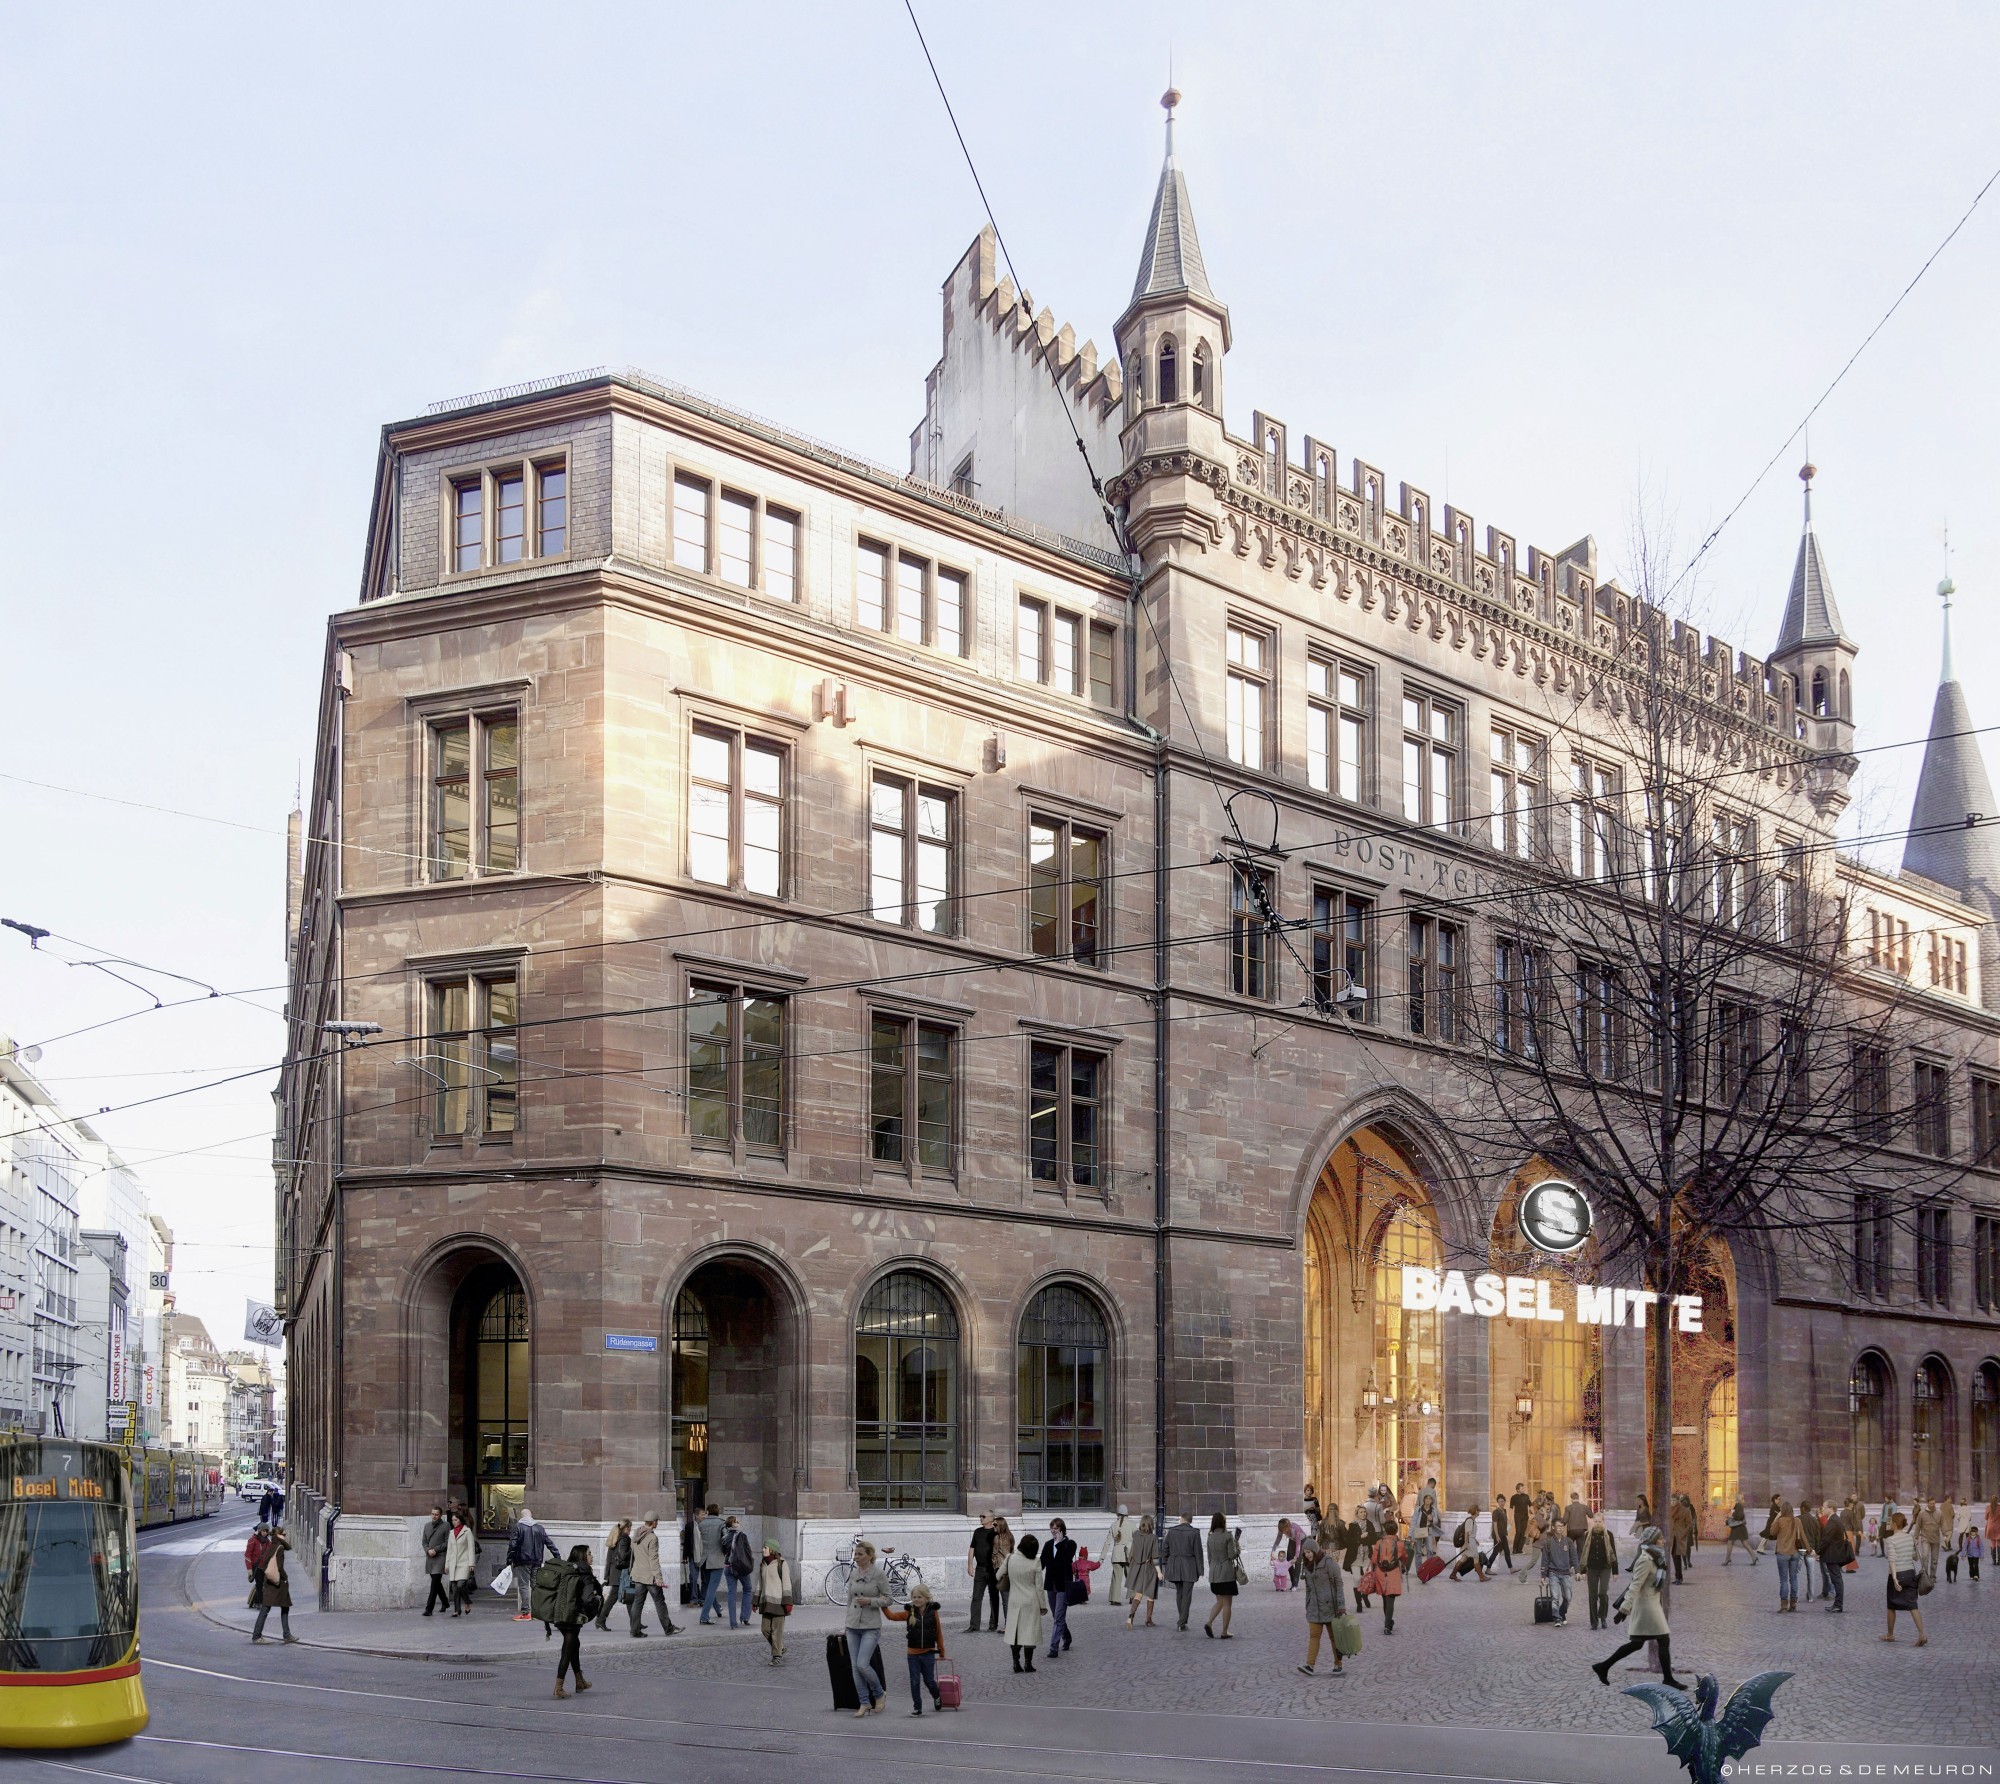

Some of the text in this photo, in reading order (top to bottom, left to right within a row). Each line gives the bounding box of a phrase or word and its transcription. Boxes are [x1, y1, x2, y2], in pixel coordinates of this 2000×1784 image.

[151, 1274, 168, 1288] 30
[1401, 1266, 1703, 1332] BASEL MITE
[113, 1361, 121, 1398] OCHSNER
[146, 1382, 154, 1405] coop
[62, 1455, 72, 1471] 7
